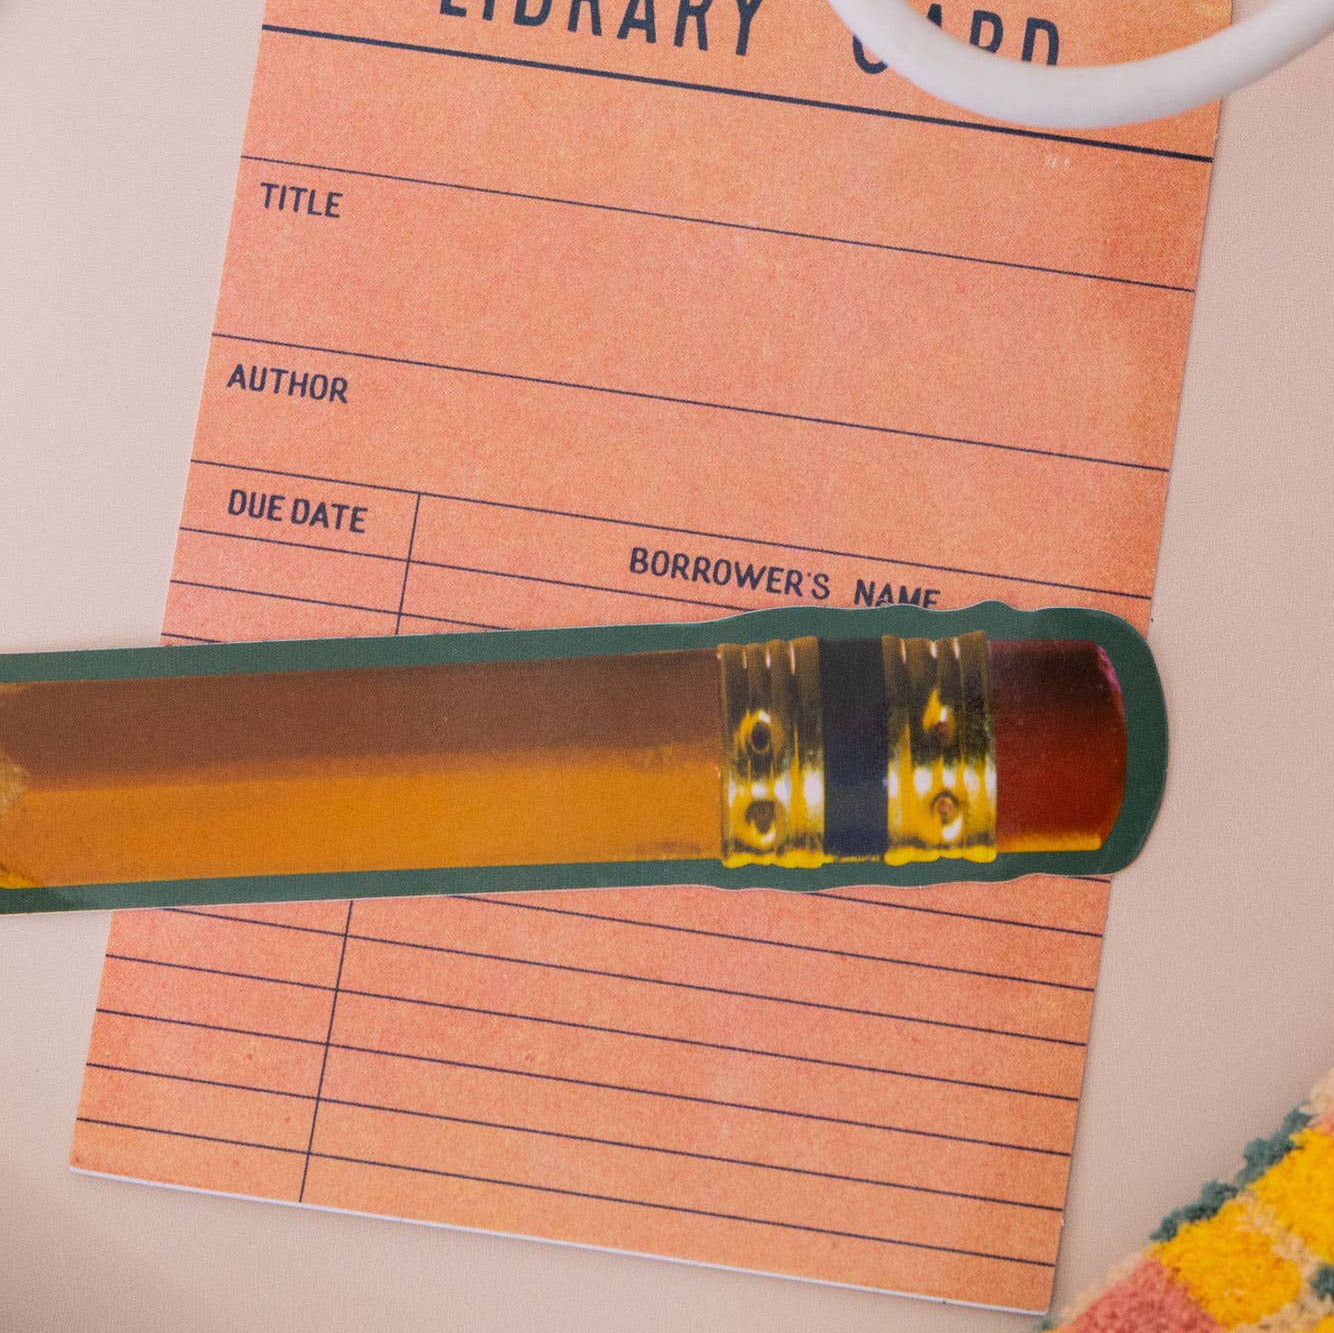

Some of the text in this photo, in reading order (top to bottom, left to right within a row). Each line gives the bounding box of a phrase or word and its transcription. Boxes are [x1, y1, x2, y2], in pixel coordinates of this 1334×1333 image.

[260, 182, 343, 218] TITLE
[226, 363, 349, 404] AUTHOR
[227, 488, 369, 534] DUE DATE
[629, 546, 941, 608] BORROWER'S NAME
